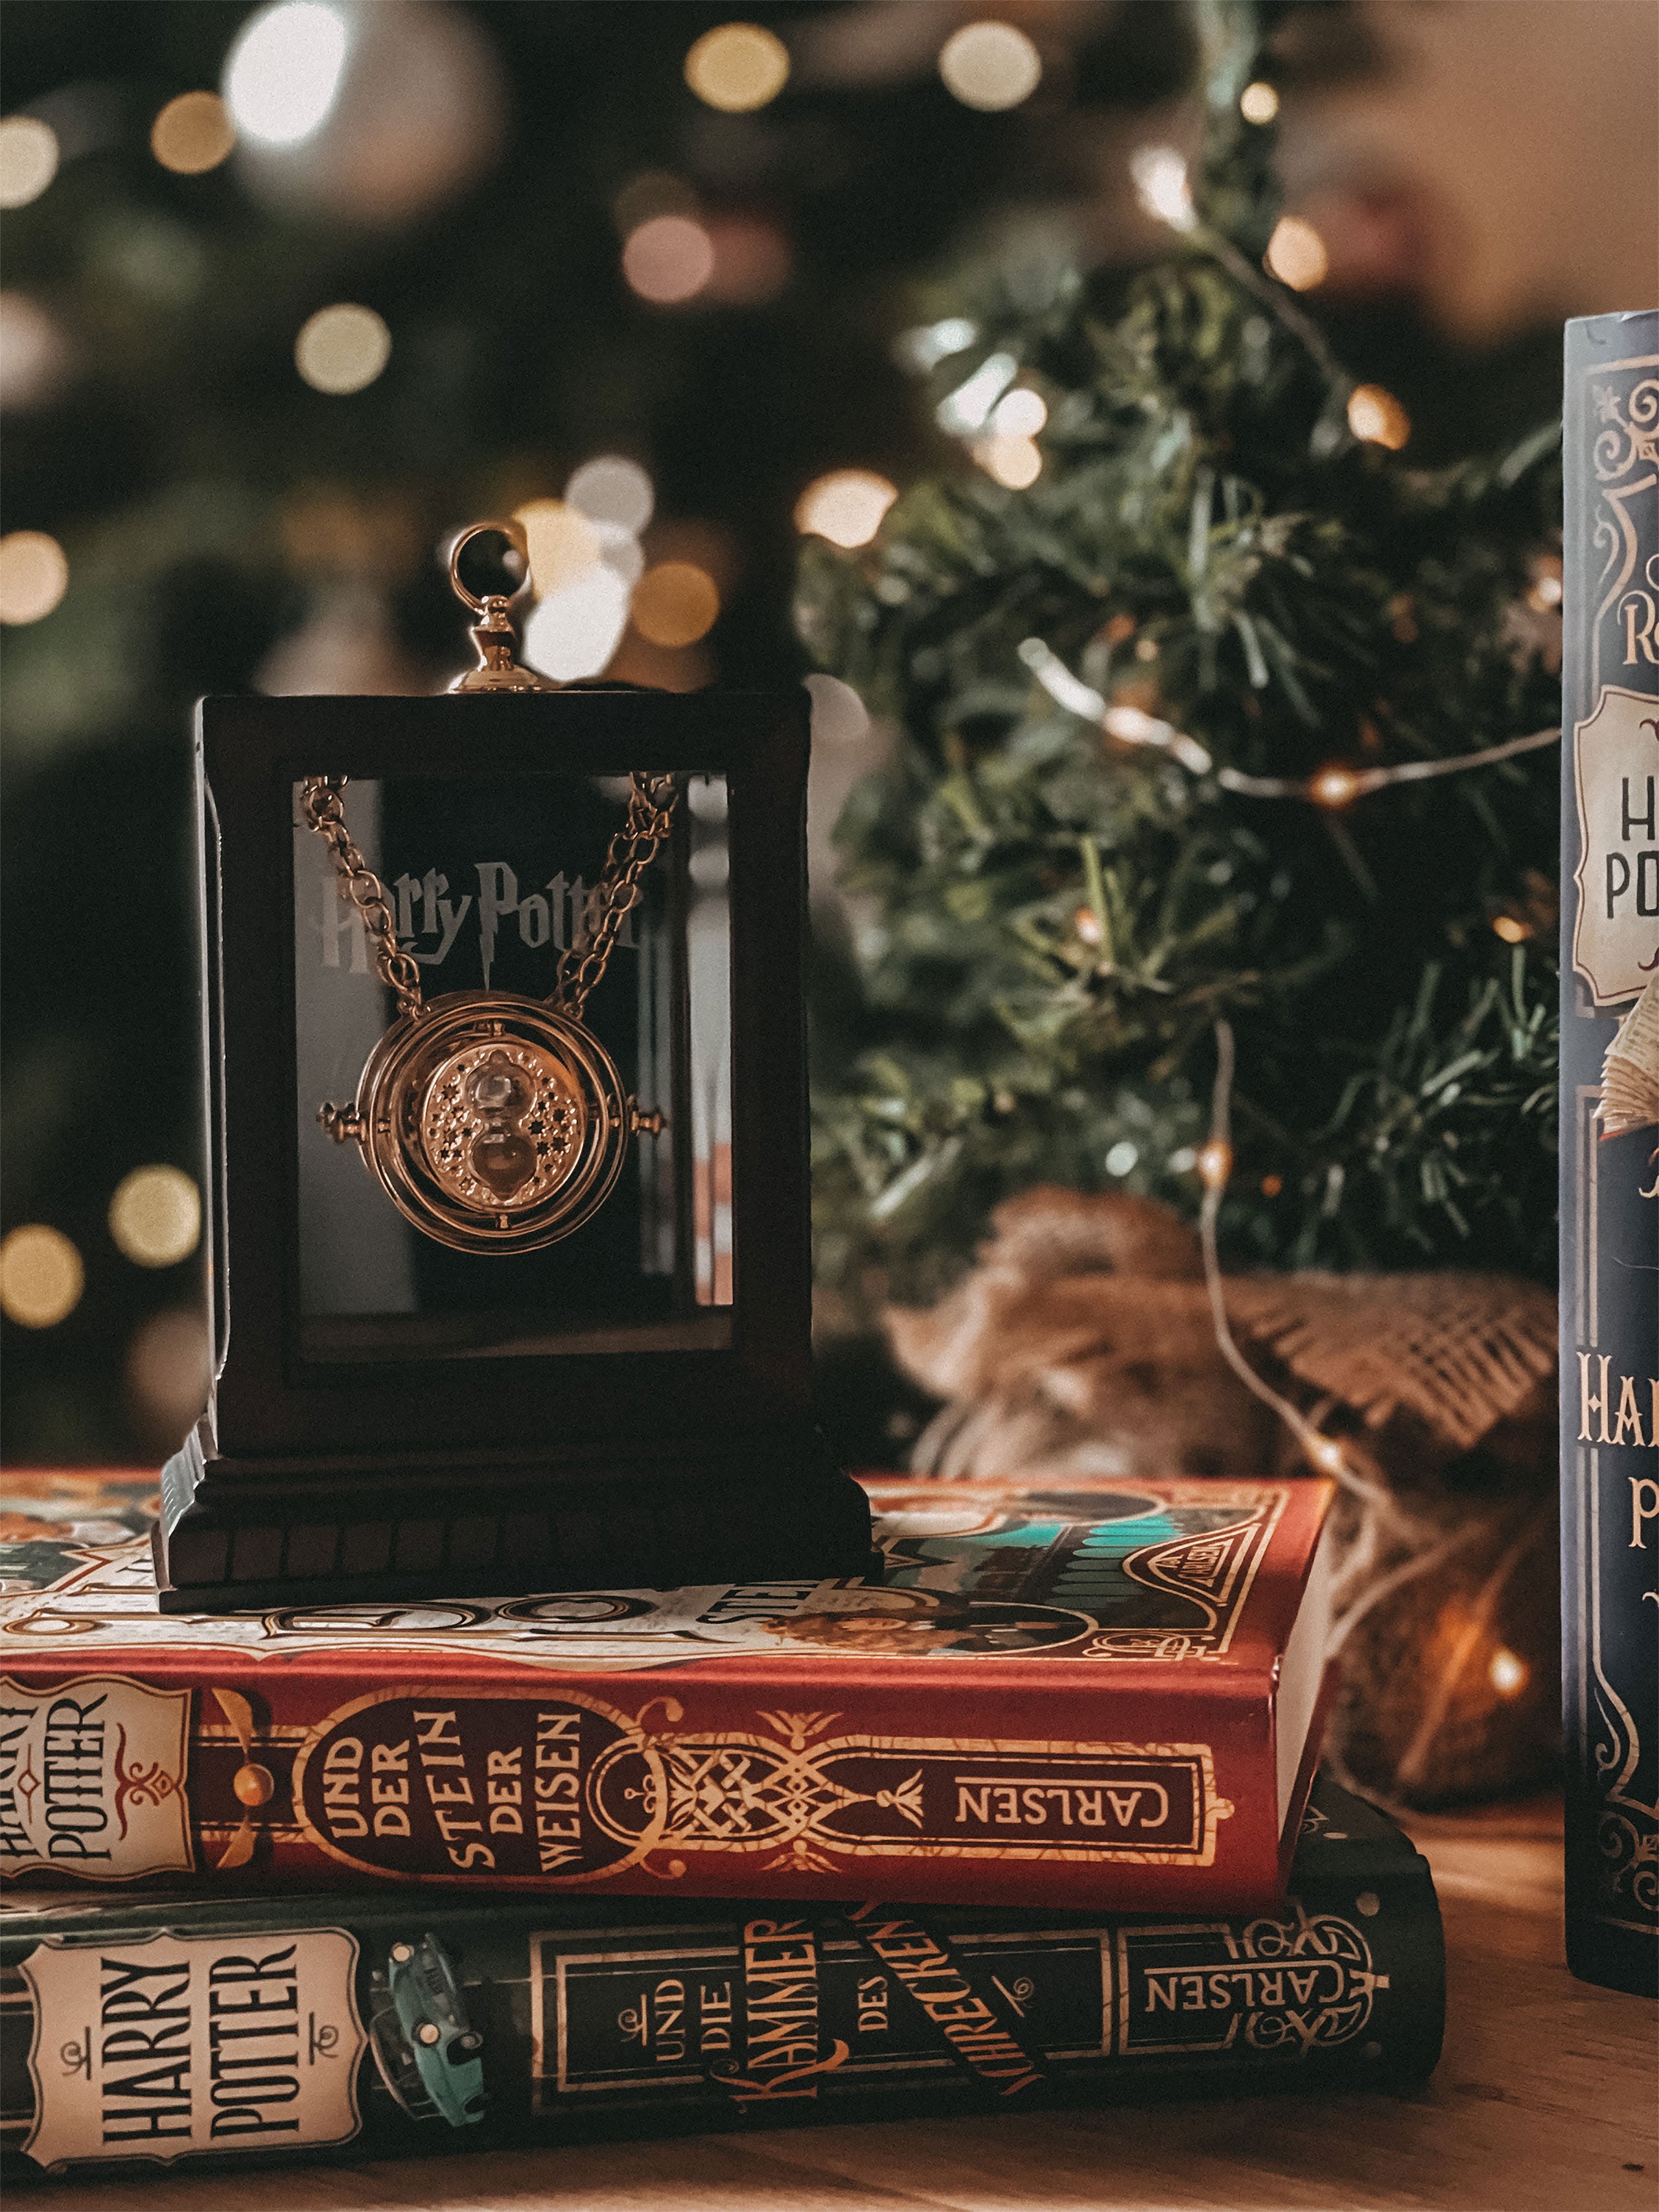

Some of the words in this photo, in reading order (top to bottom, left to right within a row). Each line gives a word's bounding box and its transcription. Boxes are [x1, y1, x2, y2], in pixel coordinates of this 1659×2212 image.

[697, 1582, 822, 1624] STEI
[43, 1694, 111, 1861] POTTER
[324, 1737, 369, 1839] UND
[372, 1740, 412, 1838] DER
[413, 1711, 496, 1869] STEIN
[487, 1747, 523, 1834] DER
[535, 1712, 581, 1872] WEISEN
[955, 1776, 1168, 1828] CARLSEN
[654, 1979, 686, 2062] UND
[701, 1981, 732, 2051] DIE
[712, 1918, 850, 2113] KAMMER
[857, 1975, 888, 2032] DES
[1144, 1959, 1345, 2012] CARLSEN
[100, 1957, 192, 2143] HARRY
[209, 1944, 301, 2140] POTTER
